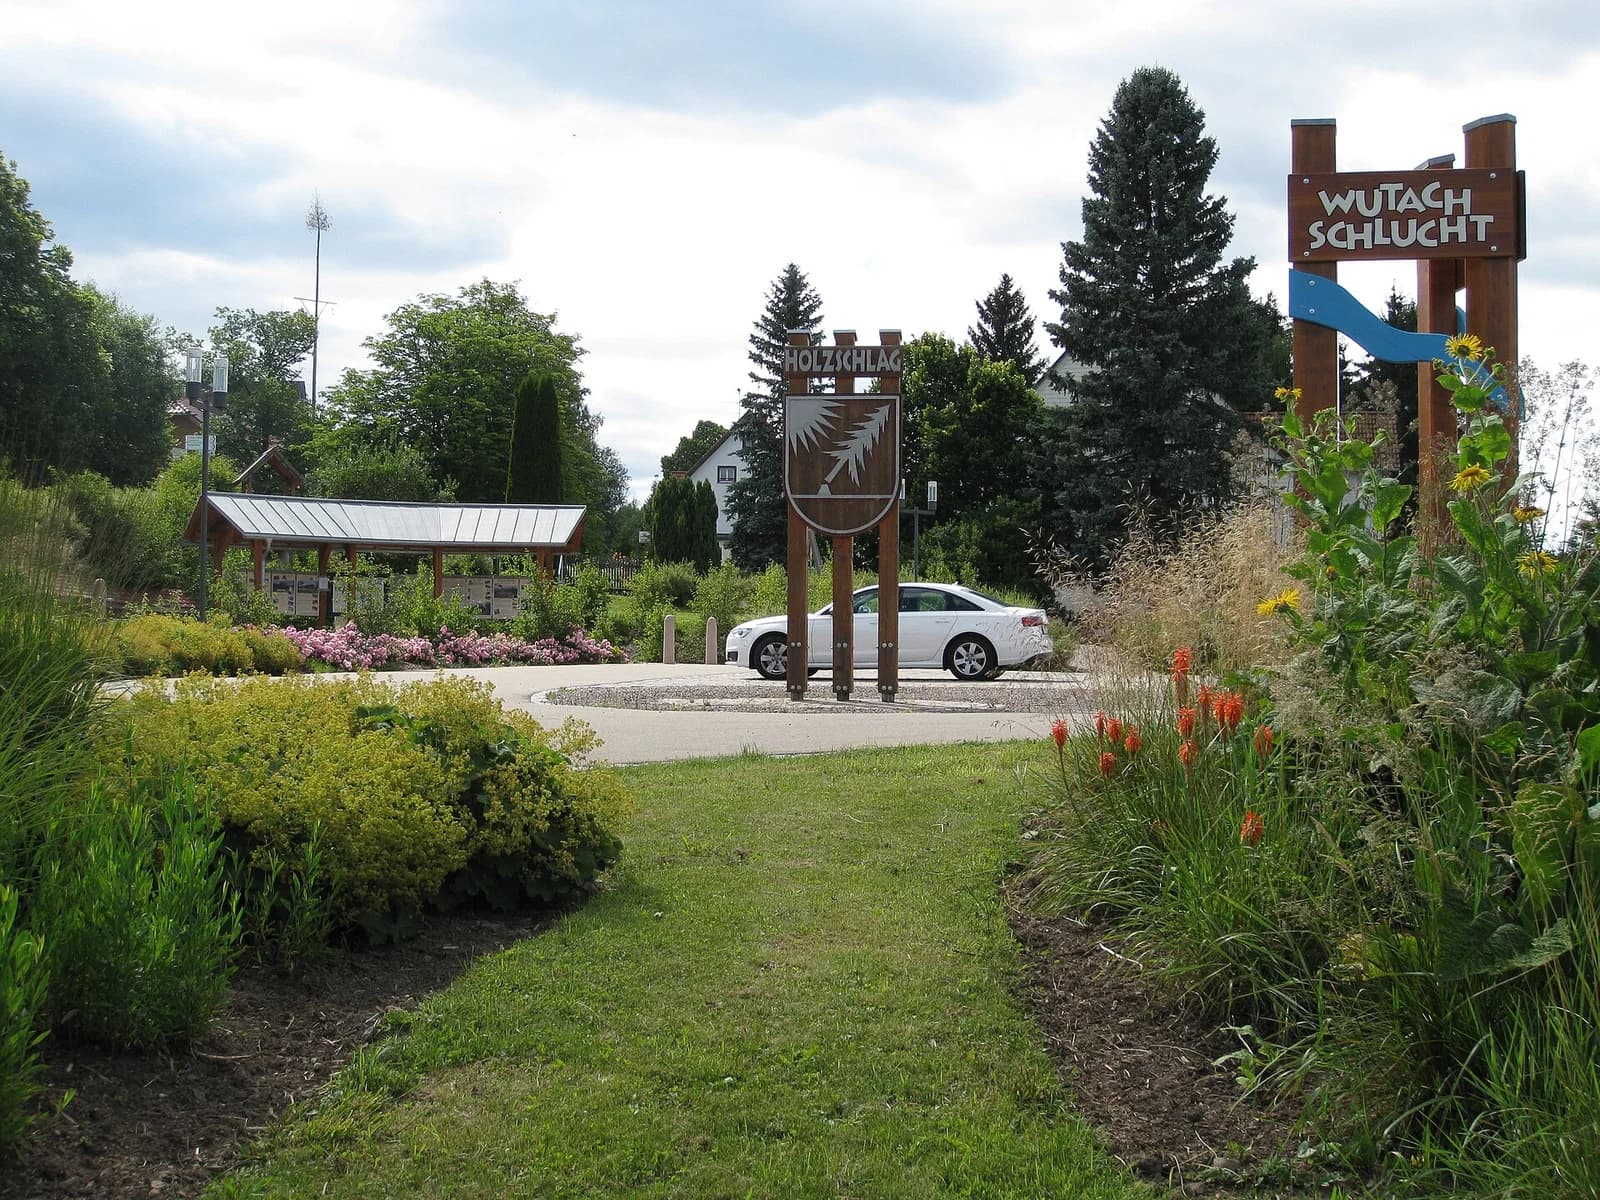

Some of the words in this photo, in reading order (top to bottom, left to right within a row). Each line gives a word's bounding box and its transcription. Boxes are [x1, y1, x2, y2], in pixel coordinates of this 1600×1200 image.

[1318, 182, 1471, 217] WUTACH
[1308, 215, 1495, 250] SCHLUCHT
[785, 349, 900, 372] HOLZSCHLAG
